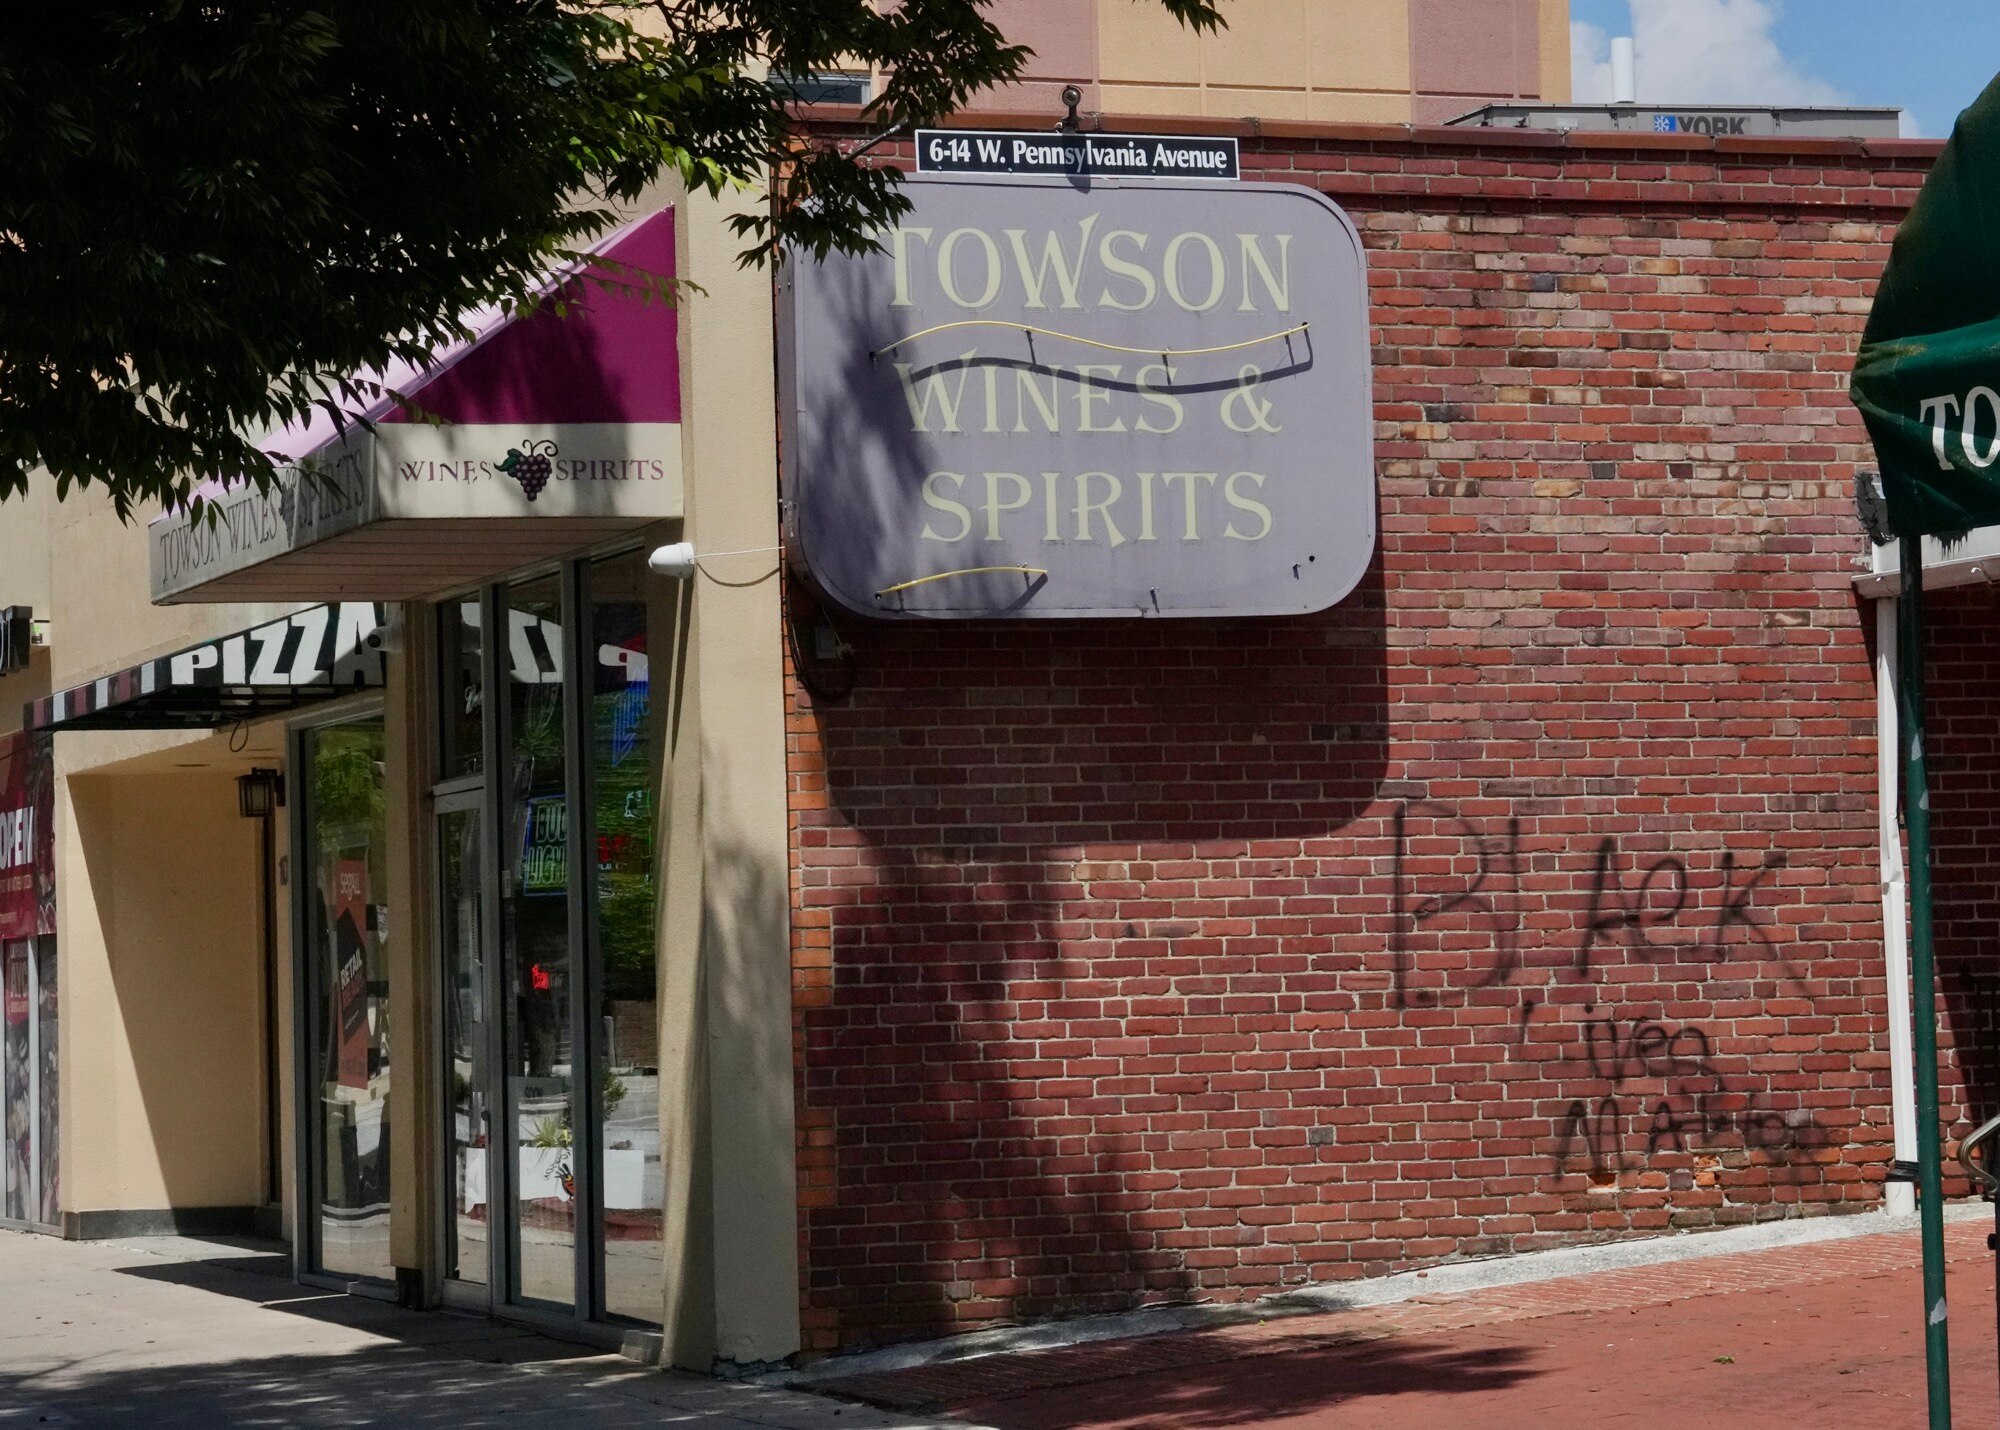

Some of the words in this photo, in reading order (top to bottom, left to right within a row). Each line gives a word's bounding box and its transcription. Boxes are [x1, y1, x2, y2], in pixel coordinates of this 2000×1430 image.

[929, 138, 971, 163] 6-14
[976, 140, 1006, 164] W.
[1013, 140, 1149, 174] Pennsylvania
[1153, 144, 1228, 169] Avenue
[1677, 115, 1746, 135] YORK
[865, 211, 1294, 312] TOWSON
[895, 347, 1184, 436] WINES
[1219, 362, 1283, 434] &
[400, 460, 493, 484] WINES
[556, 459, 664, 481] SPIRITS
[918, 471, 1273, 548] SPIRITS
[160, 508, 222, 585] TOWSON
[226, 485, 280, 554] WINES
[170, 602, 384, 685] PIZZA
[340, 946, 363, 991] RETAIL
